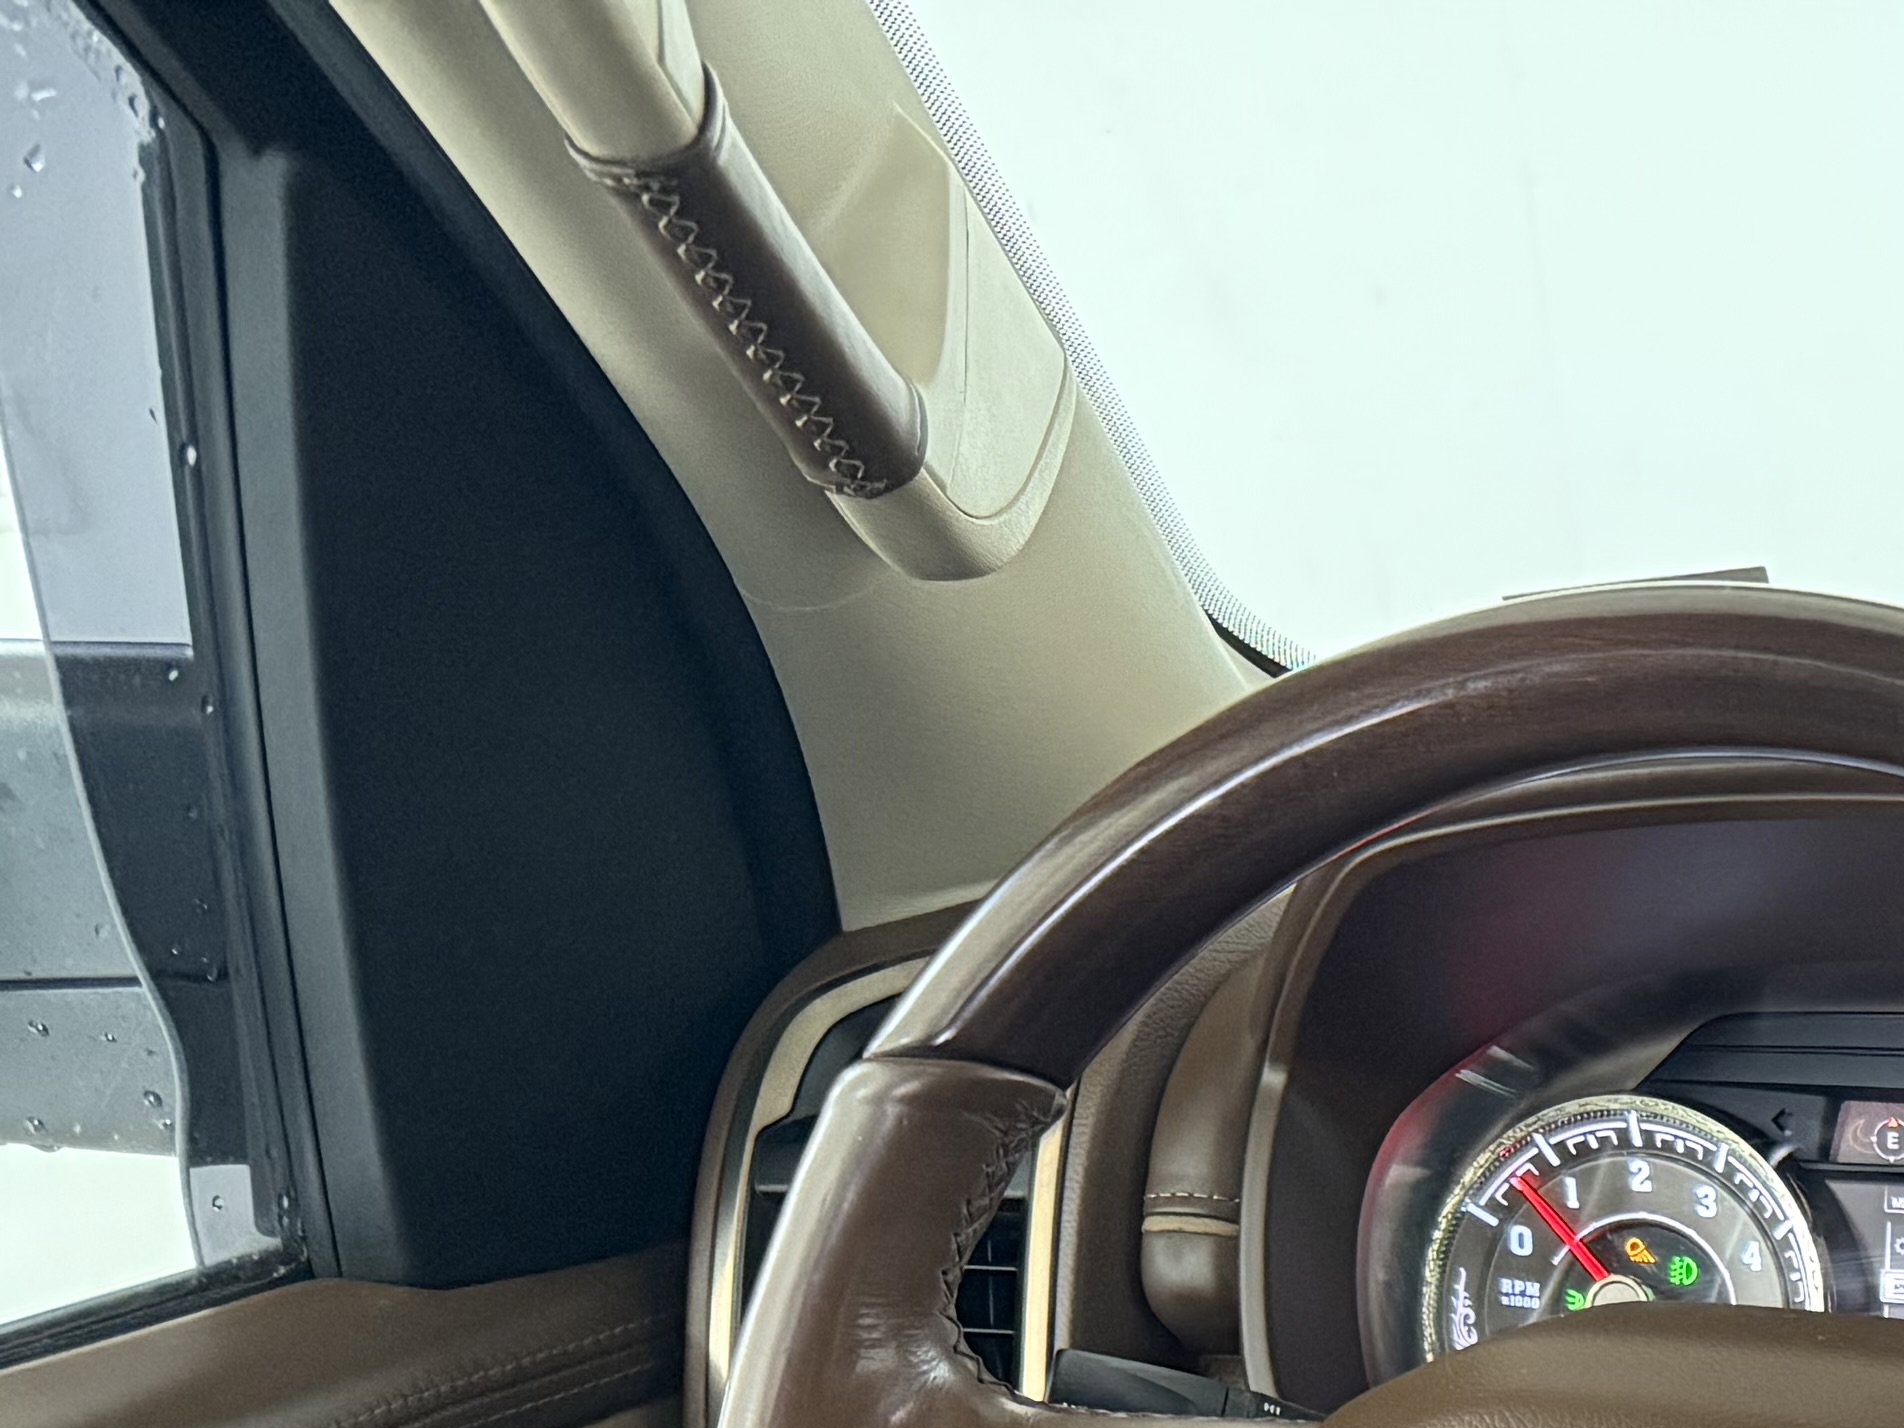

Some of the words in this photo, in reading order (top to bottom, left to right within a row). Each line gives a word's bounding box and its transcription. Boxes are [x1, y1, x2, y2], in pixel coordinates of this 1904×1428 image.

[1886, 1131, 1900, 1150] E
[1628, 1158, 1653, 1193] 2
[1564, 1176, 1580, 1209] 1
[1695, 1185, 1718, 1218] 3
[1508, 1224, 1534, 1257] 0
[1741, 1240, 1762, 1272] 4
[1500, 1277, 1541, 1295] RPM
